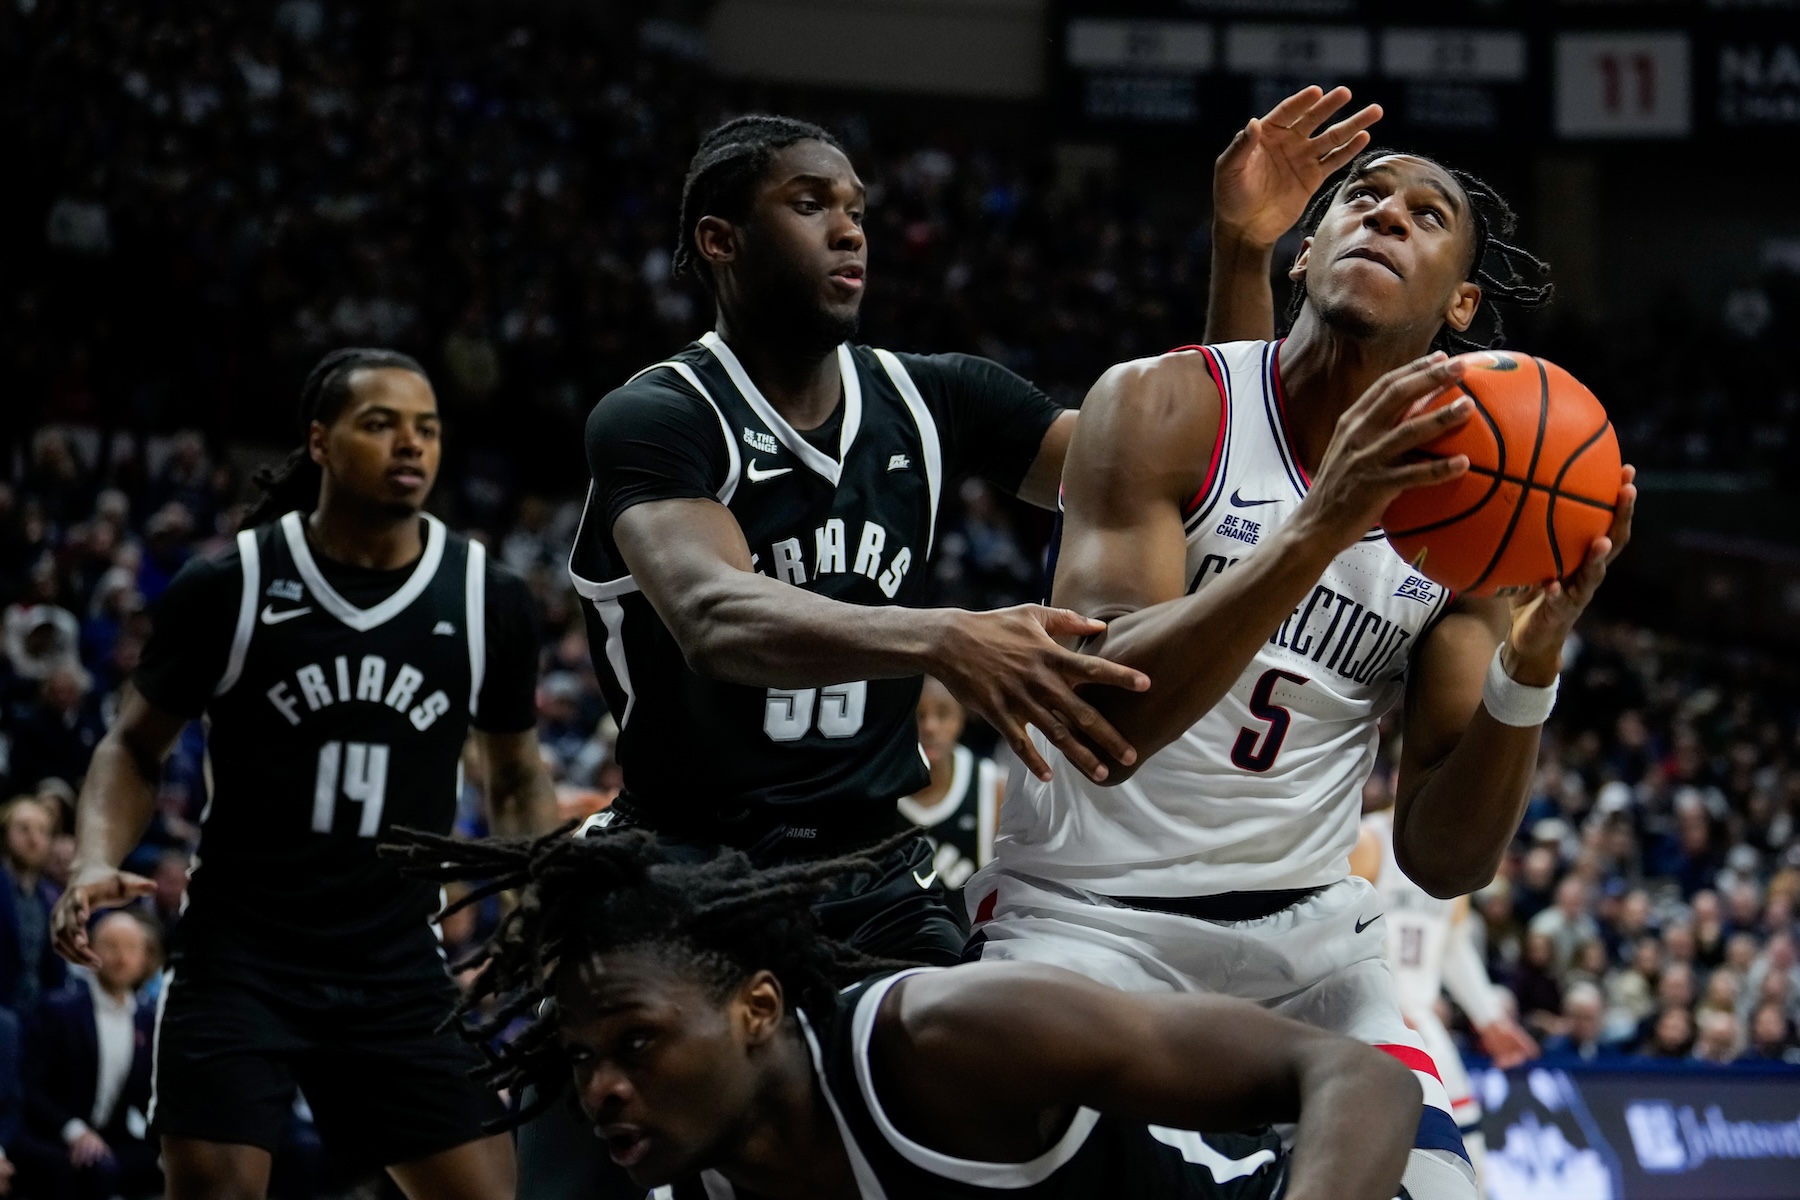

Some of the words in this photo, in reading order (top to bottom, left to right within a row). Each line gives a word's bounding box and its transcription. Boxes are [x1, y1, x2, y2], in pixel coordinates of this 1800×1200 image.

[1596, 51, 1657, 116] 11
[743, 433, 778, 455] CHANGE
[744, 427, 755, 439] BE
[756, 432, 775, 445] THE
[1216, 524, 1260, 545] CHANGE
[1223, 514, 1240, 527] BE
[1241, 519, 1262, 534] THE
[1397, 584, 1437, 602] EAST
[1404, 575, 1433, 590] BIG
[266, 654, 450, 732] FRIARS
[1230, 668, 1311, 773] 5
[311, 740, 391, 838] 14
